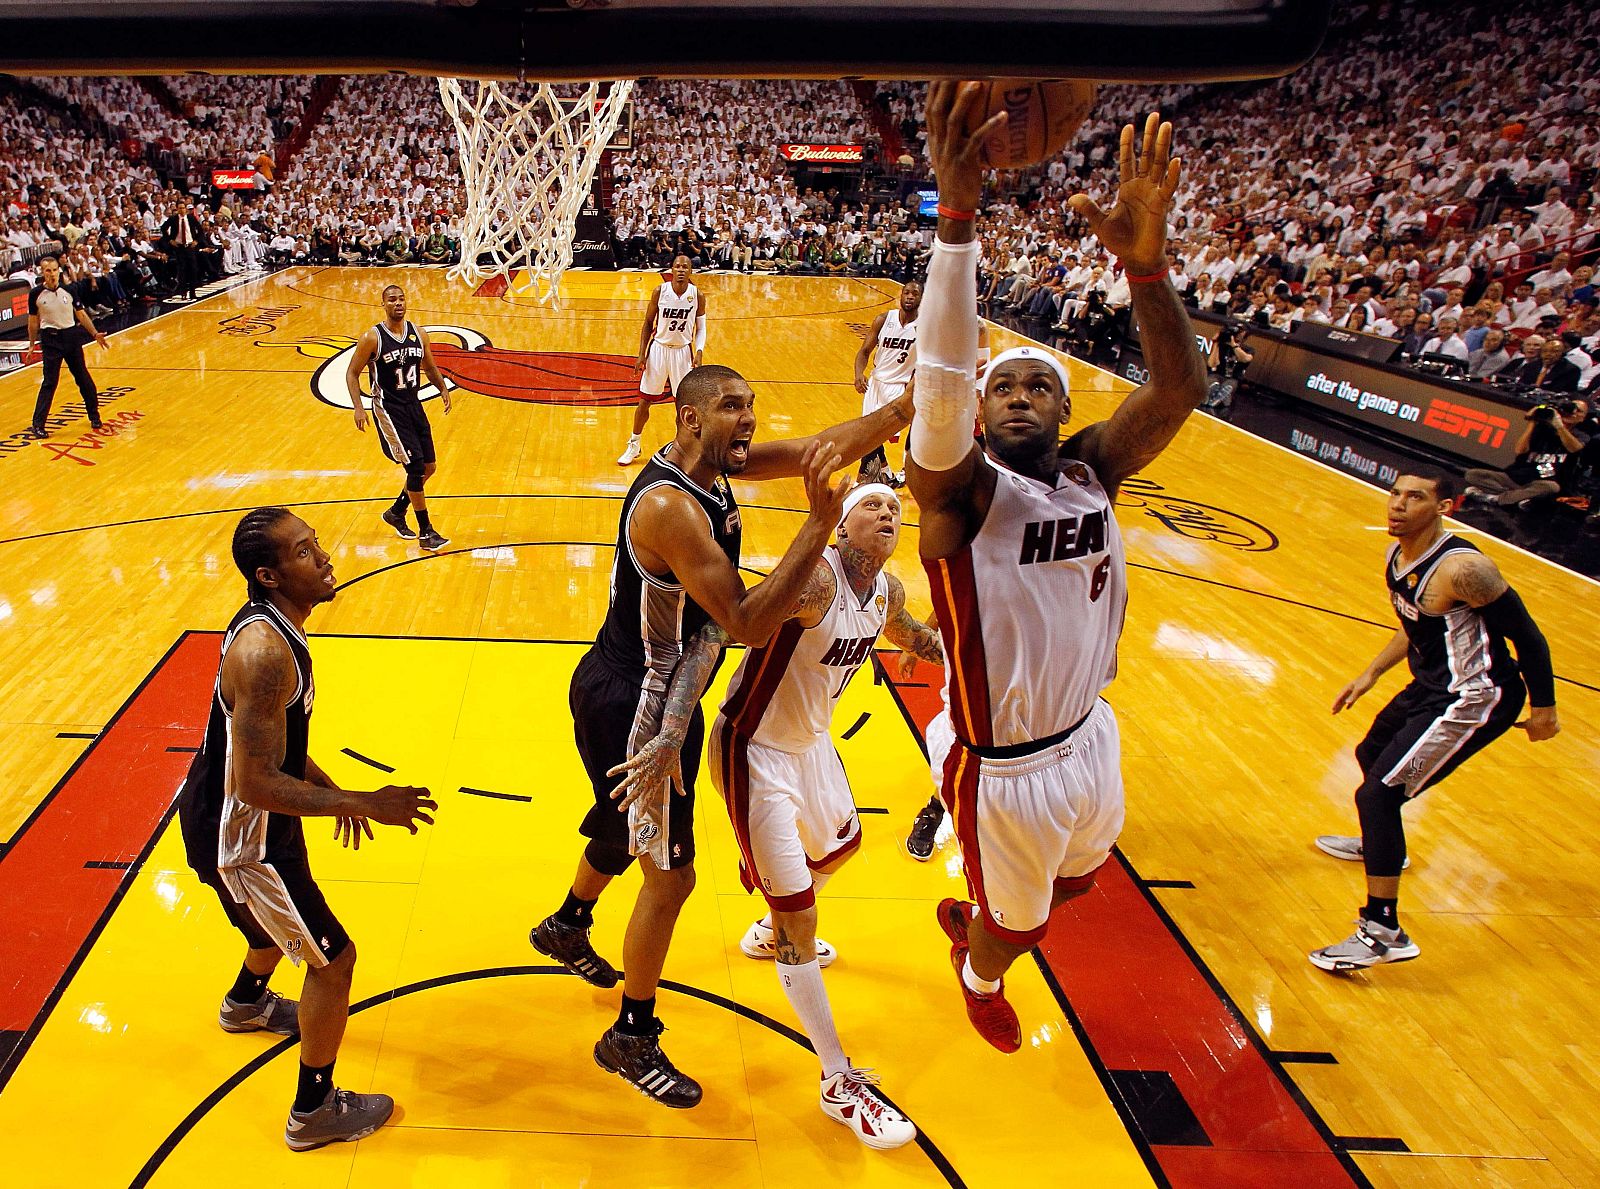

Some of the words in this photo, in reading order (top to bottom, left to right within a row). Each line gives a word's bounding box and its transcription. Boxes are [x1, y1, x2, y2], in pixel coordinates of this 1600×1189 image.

[788, 145, 863, 160] Budweise
[214, 174, 254, 184] Budwei
[573, 240, 610, 252] Finals
[663, 306, 694, 319] HEAT
[669, 320, 687, 332] 34
[883, 337, 916, 350] HEAT
[383, 347, 422, 365] SPURS
[897, 352, 908, 364] 3
[395, 364, 417, 389] 14
[1307, 373, 1338, 395] after
[1337, 381, 1360, 402] the
[1358, 391, 1399, 415] game
[1399, 403, 1420, 422] on
[1423, 399, 1510, 449] ESPN
[41, 410, 146, 467] Arena
[1089, 554, 1111, 603] 6
